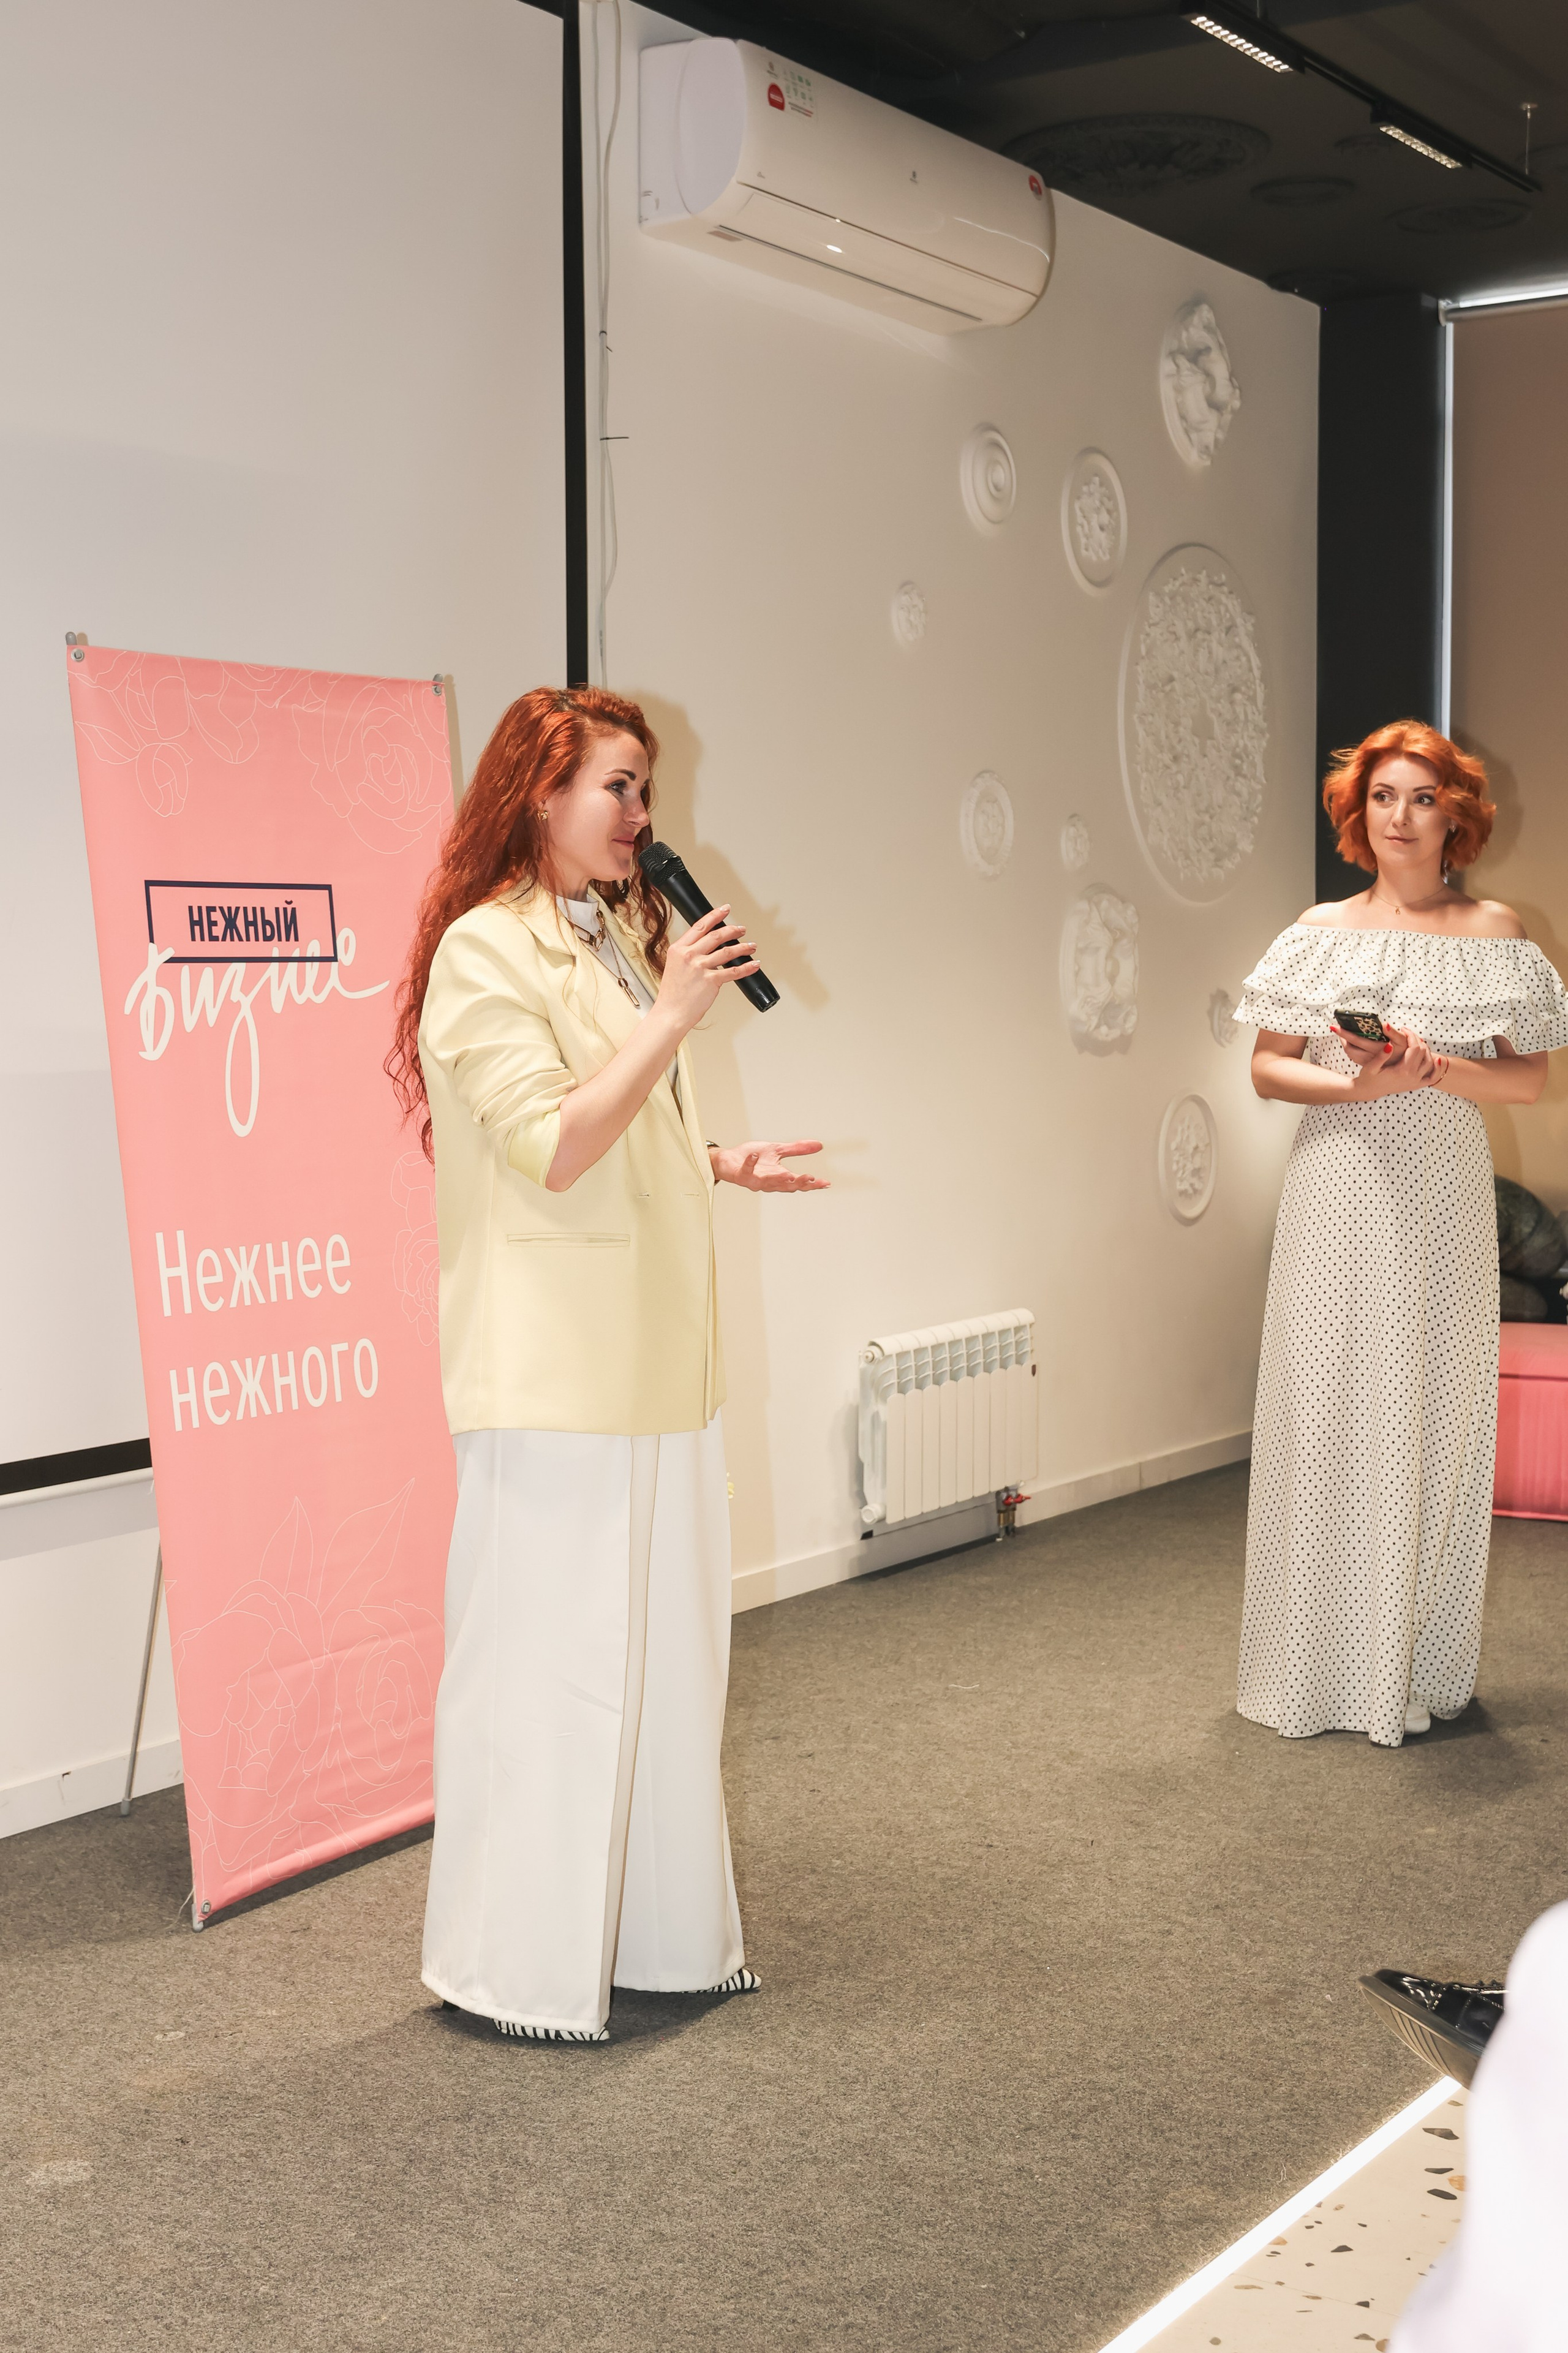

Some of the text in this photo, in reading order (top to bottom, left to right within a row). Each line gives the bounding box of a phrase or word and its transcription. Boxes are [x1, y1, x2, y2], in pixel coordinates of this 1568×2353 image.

[187, 899, 300, 942] НЕЖНЫЙ
[155, 1229, 352, 1317] Нежнее
[169, 1338, 379, 1432] нежного
